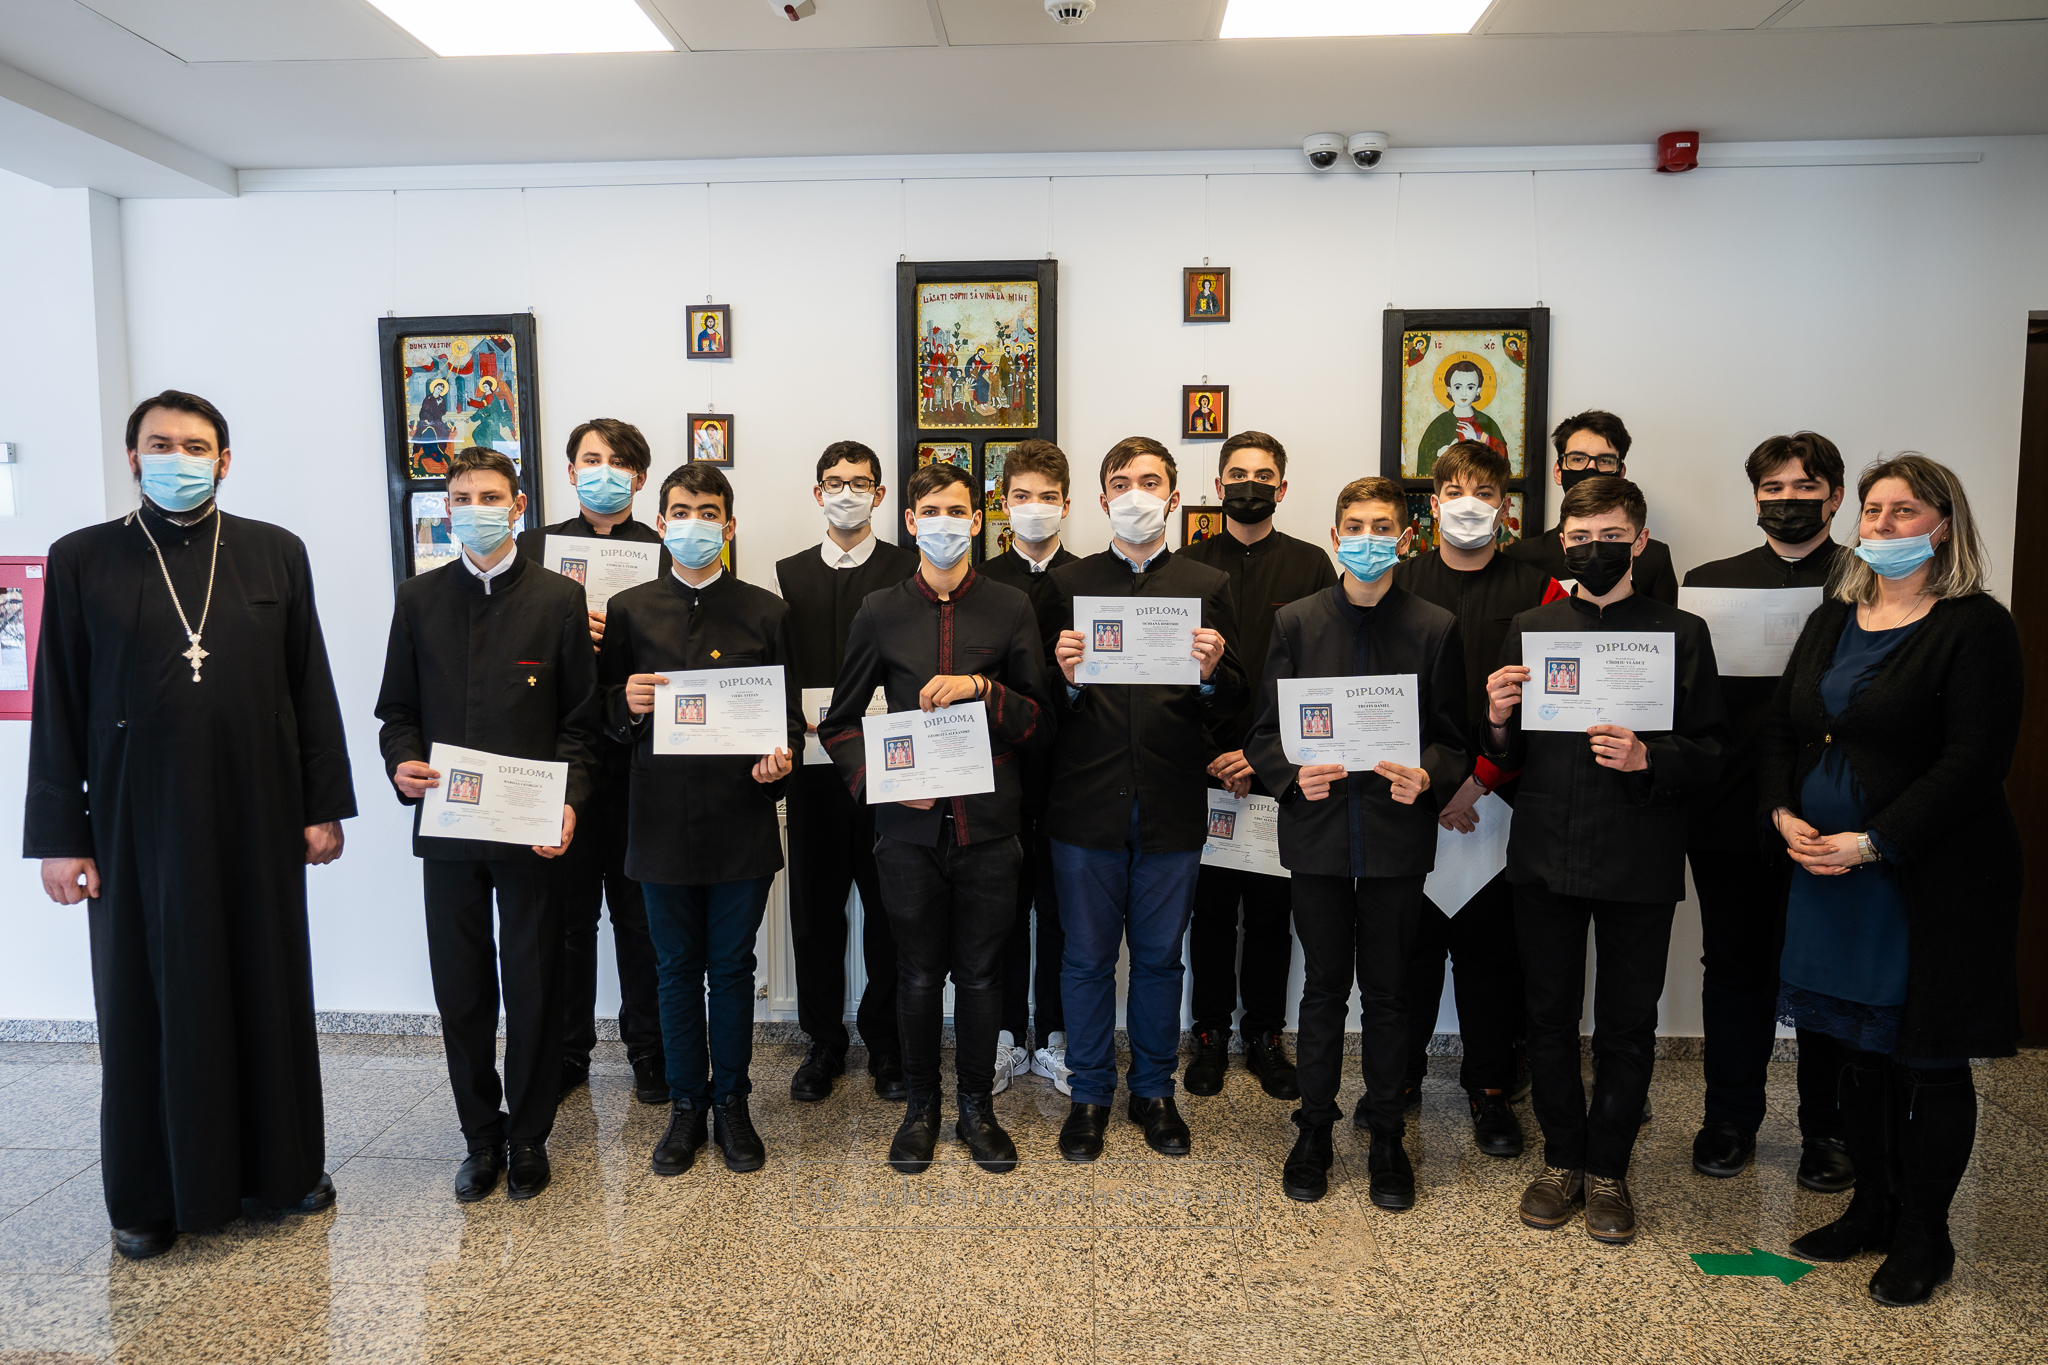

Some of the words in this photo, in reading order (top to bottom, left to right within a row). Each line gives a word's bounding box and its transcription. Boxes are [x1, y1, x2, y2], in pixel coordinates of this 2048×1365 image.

[600, 549, 648, 561] DIPLOMA
[1135, 606, 1189, 617] DIPLOMA
[1595, 642, 1660, 654] DIPLOMA
[719, 676, 773, 689] DIPLOMA
[1345, 686, 1405, 698] DIPLOMA
[923, 714, 975, 728] DIPLOMA
[498, 765, 554, 780] DIPLOMA
